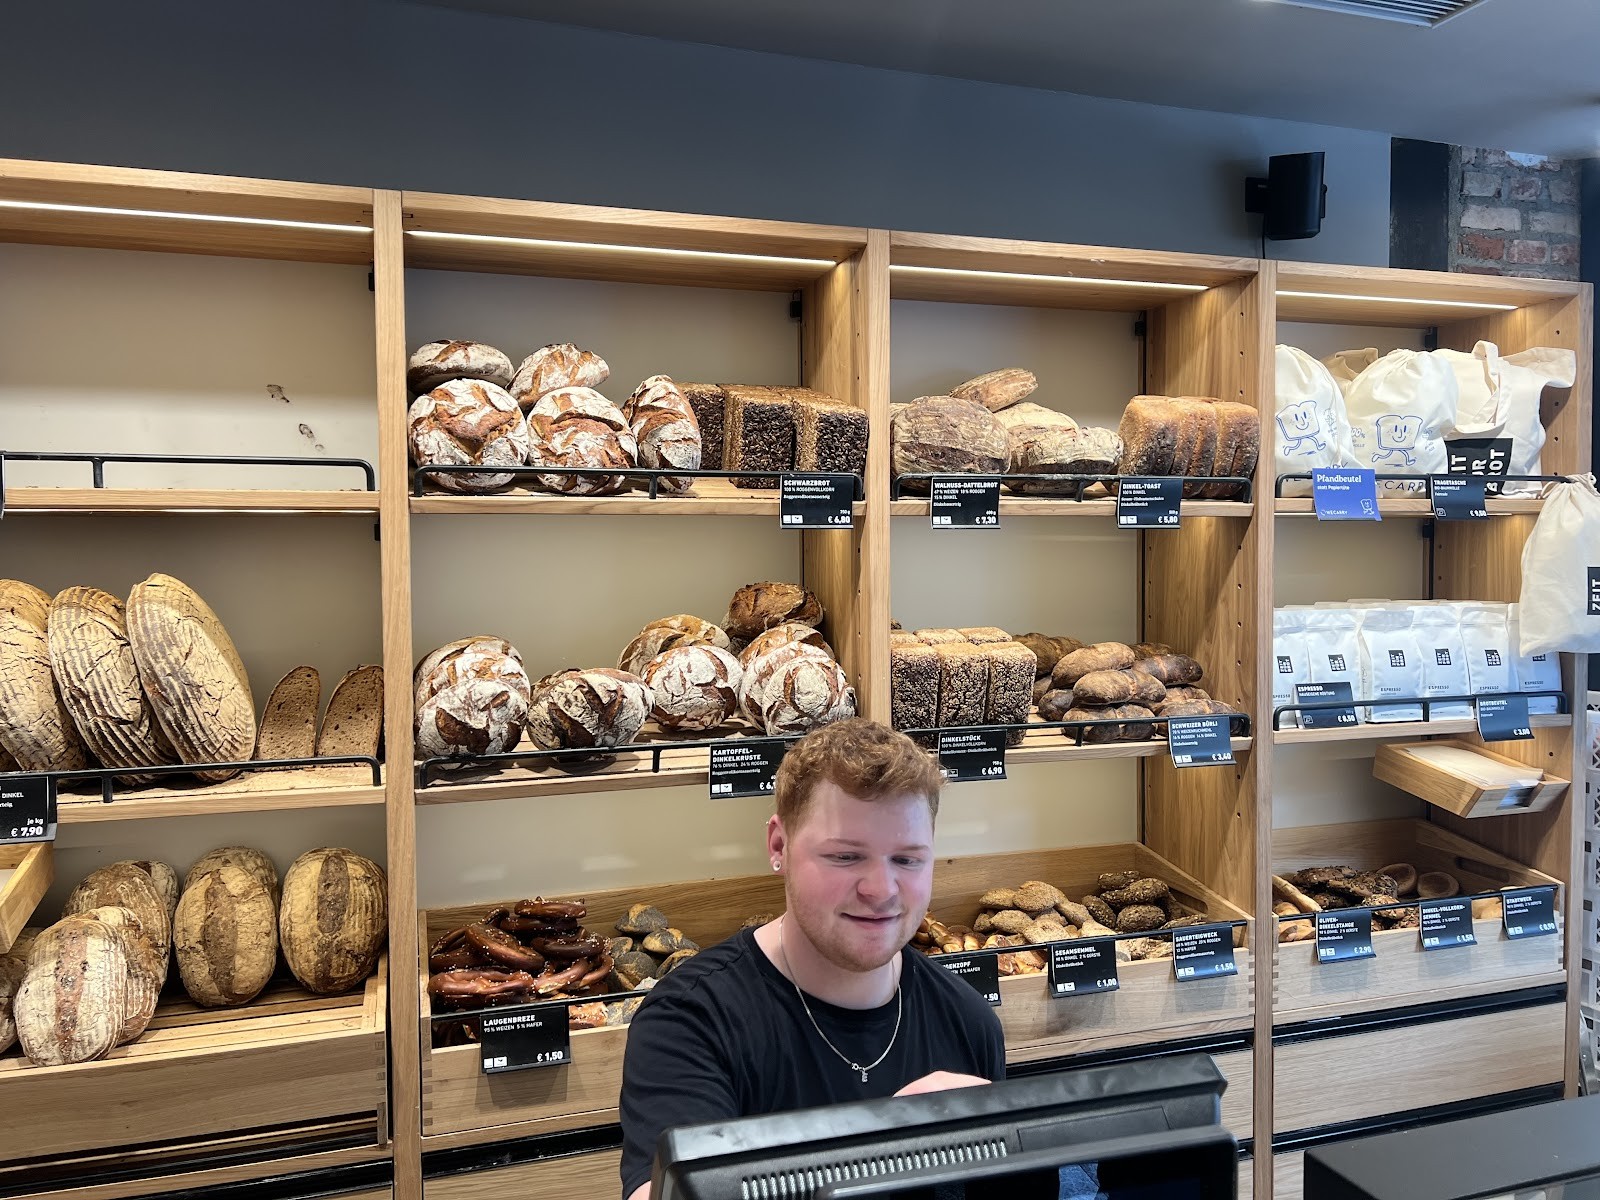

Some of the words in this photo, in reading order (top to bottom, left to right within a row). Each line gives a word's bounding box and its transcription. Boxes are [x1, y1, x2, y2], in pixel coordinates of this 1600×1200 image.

[1316, 474, 1362, 483] Pfandbeutel
[834, 516, 850, 524] 6,80
[981, 516, 996, 524] 7,30
[713, 754, 761, 762] DINKELKRUSTE
[988, 767, 1002, 775] 6,90
[11, 828, 18, 837] €
[21, 826, 43, 836] 7,90
[1176, 932, 1218, 942] SAUERTEIGWECK
[1055, 946, 1096, 956] SESAMSEMMEL
[1102, 978, 1116, 987] 1,00
[484, 1015, 535, 1026] LAUGENBREZE
[545, 1051, 563, 1061] 1,50
